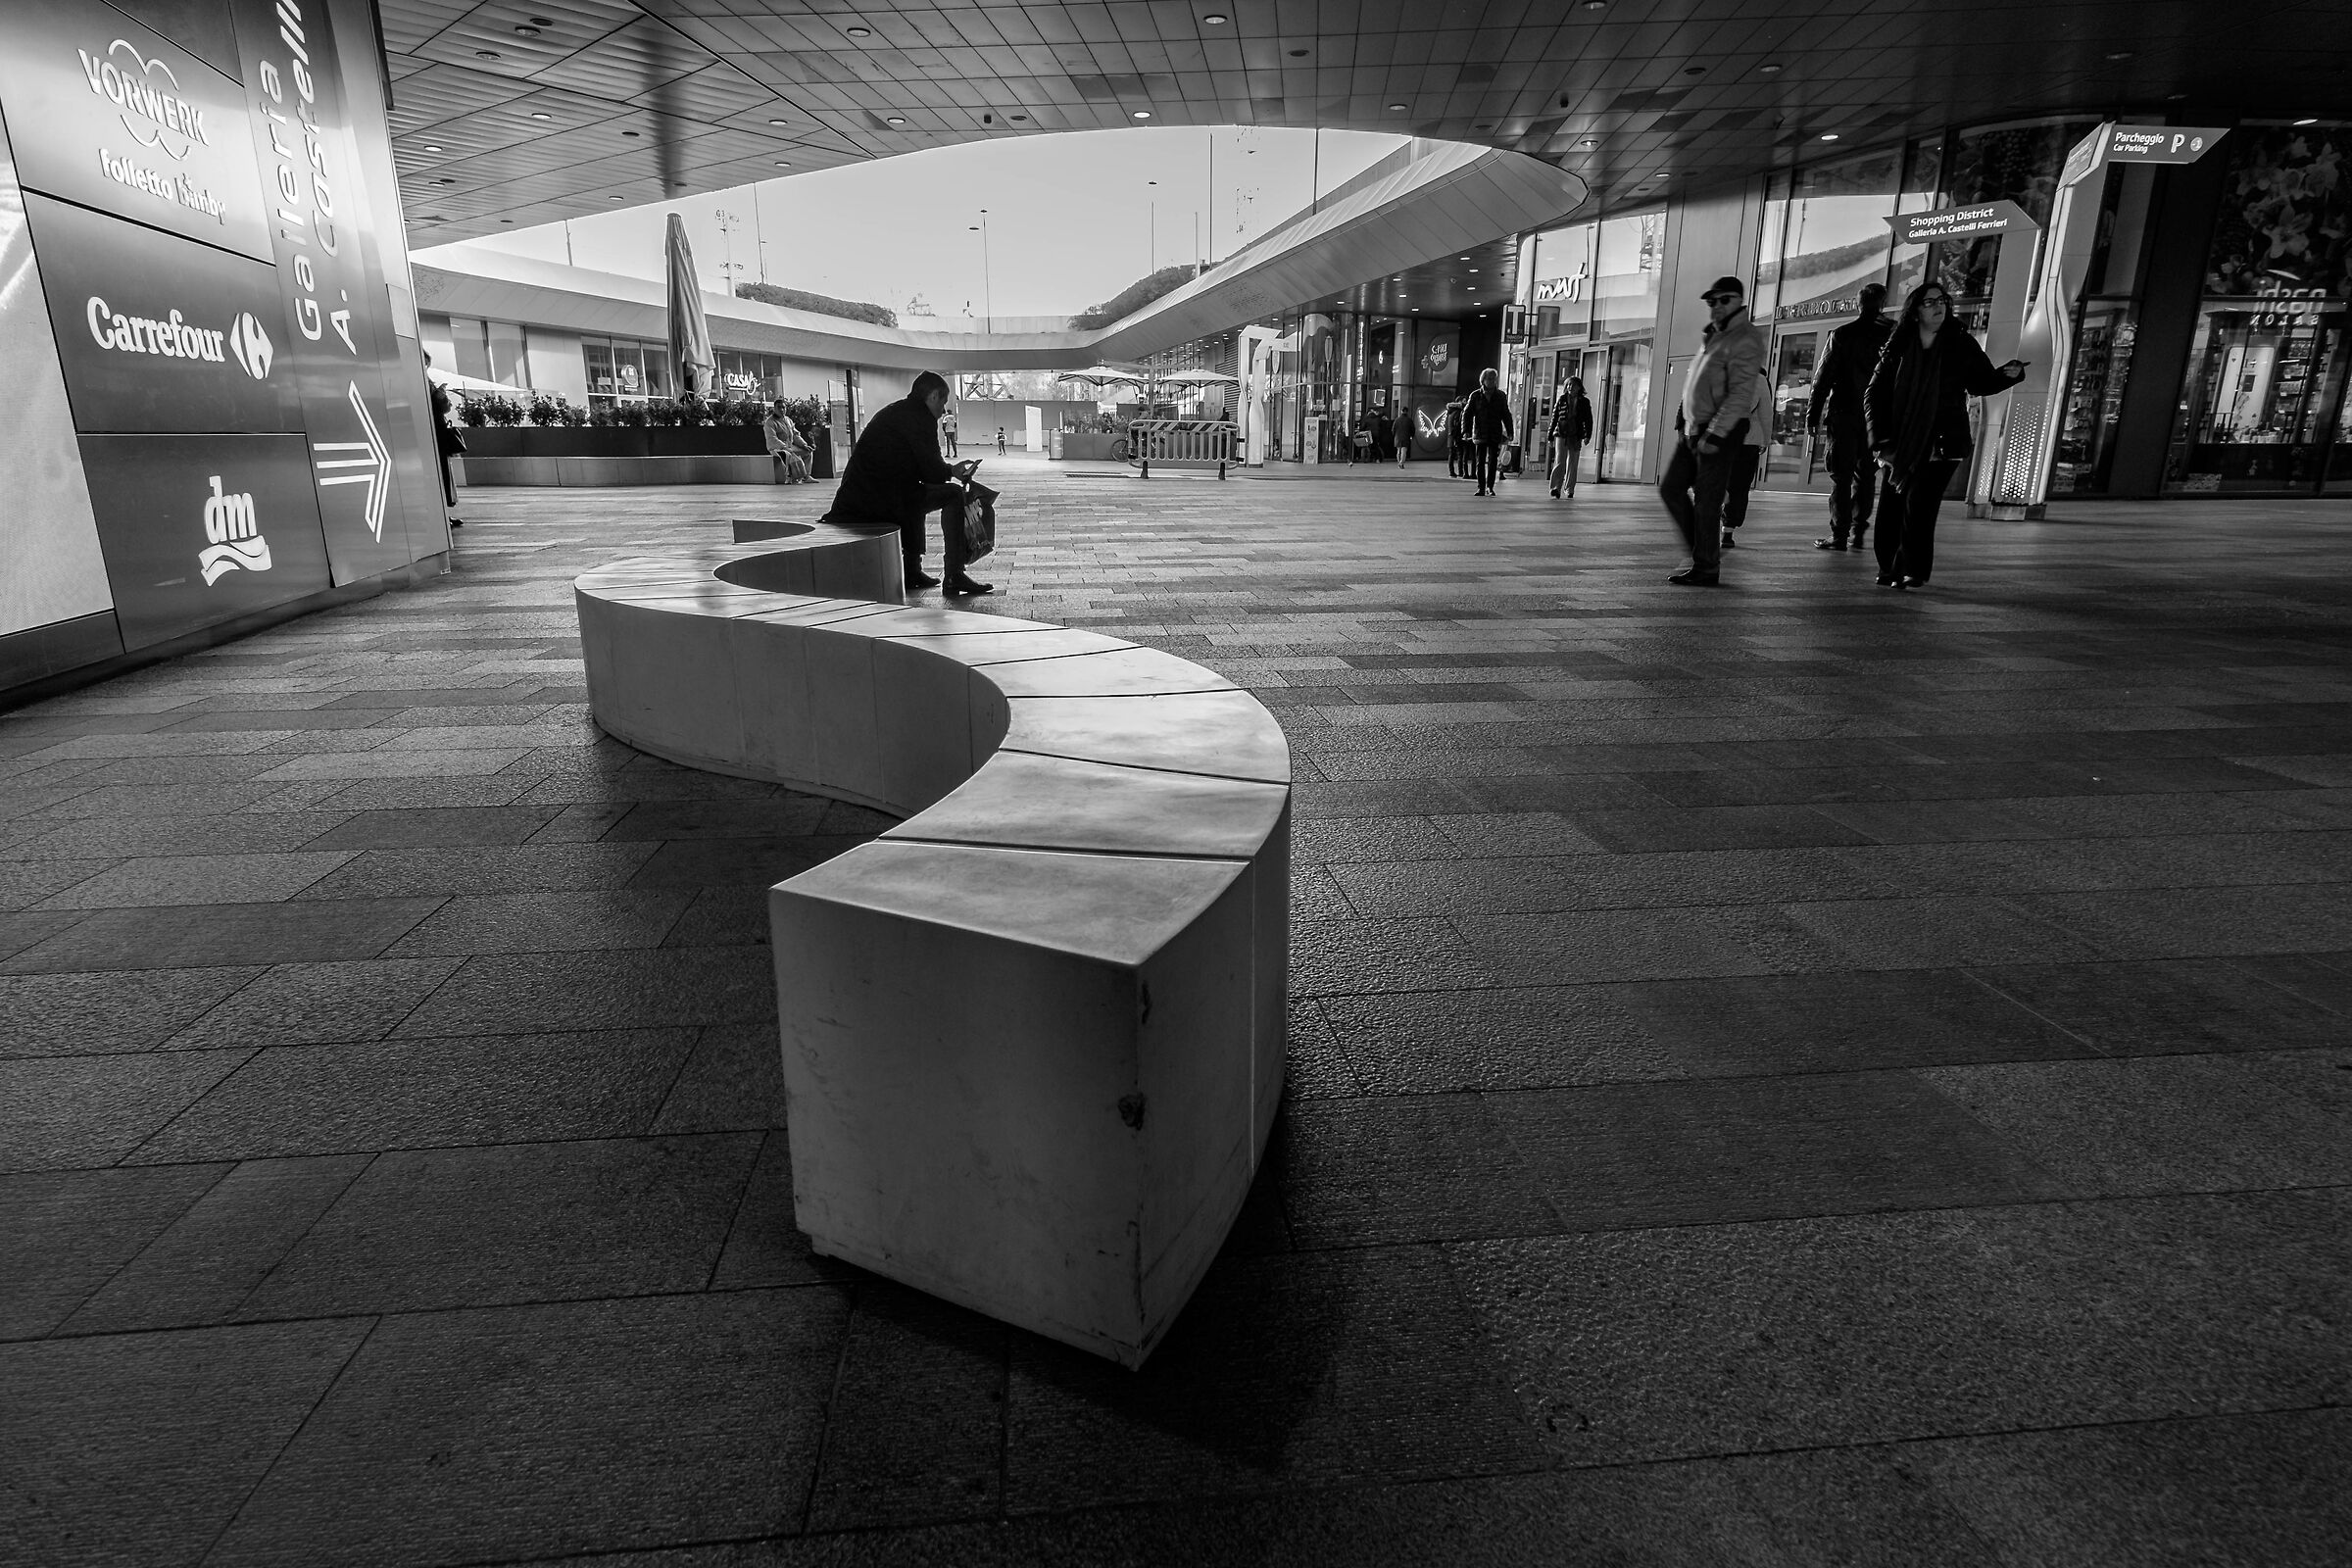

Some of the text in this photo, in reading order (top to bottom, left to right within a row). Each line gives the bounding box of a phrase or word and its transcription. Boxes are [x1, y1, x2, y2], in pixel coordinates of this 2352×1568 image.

[77, 48, 210, 148] VORWERK
[2115, 131, 2165, 146] Parcheggio
[2171, 133, 2185, 154] P
[2124, 144, 2149, 155] Parking
[259, 60, 322, 341] Galleria
[1908, 218, 2008, 238] Galleria A. Castelli Ferrieri
[1909, 207, 1994, 227] Shopping District
[86, 296, 225, 363] Carrefour
[328, 289, 358, 356] A.
[204, 475, 258, 545] dm
